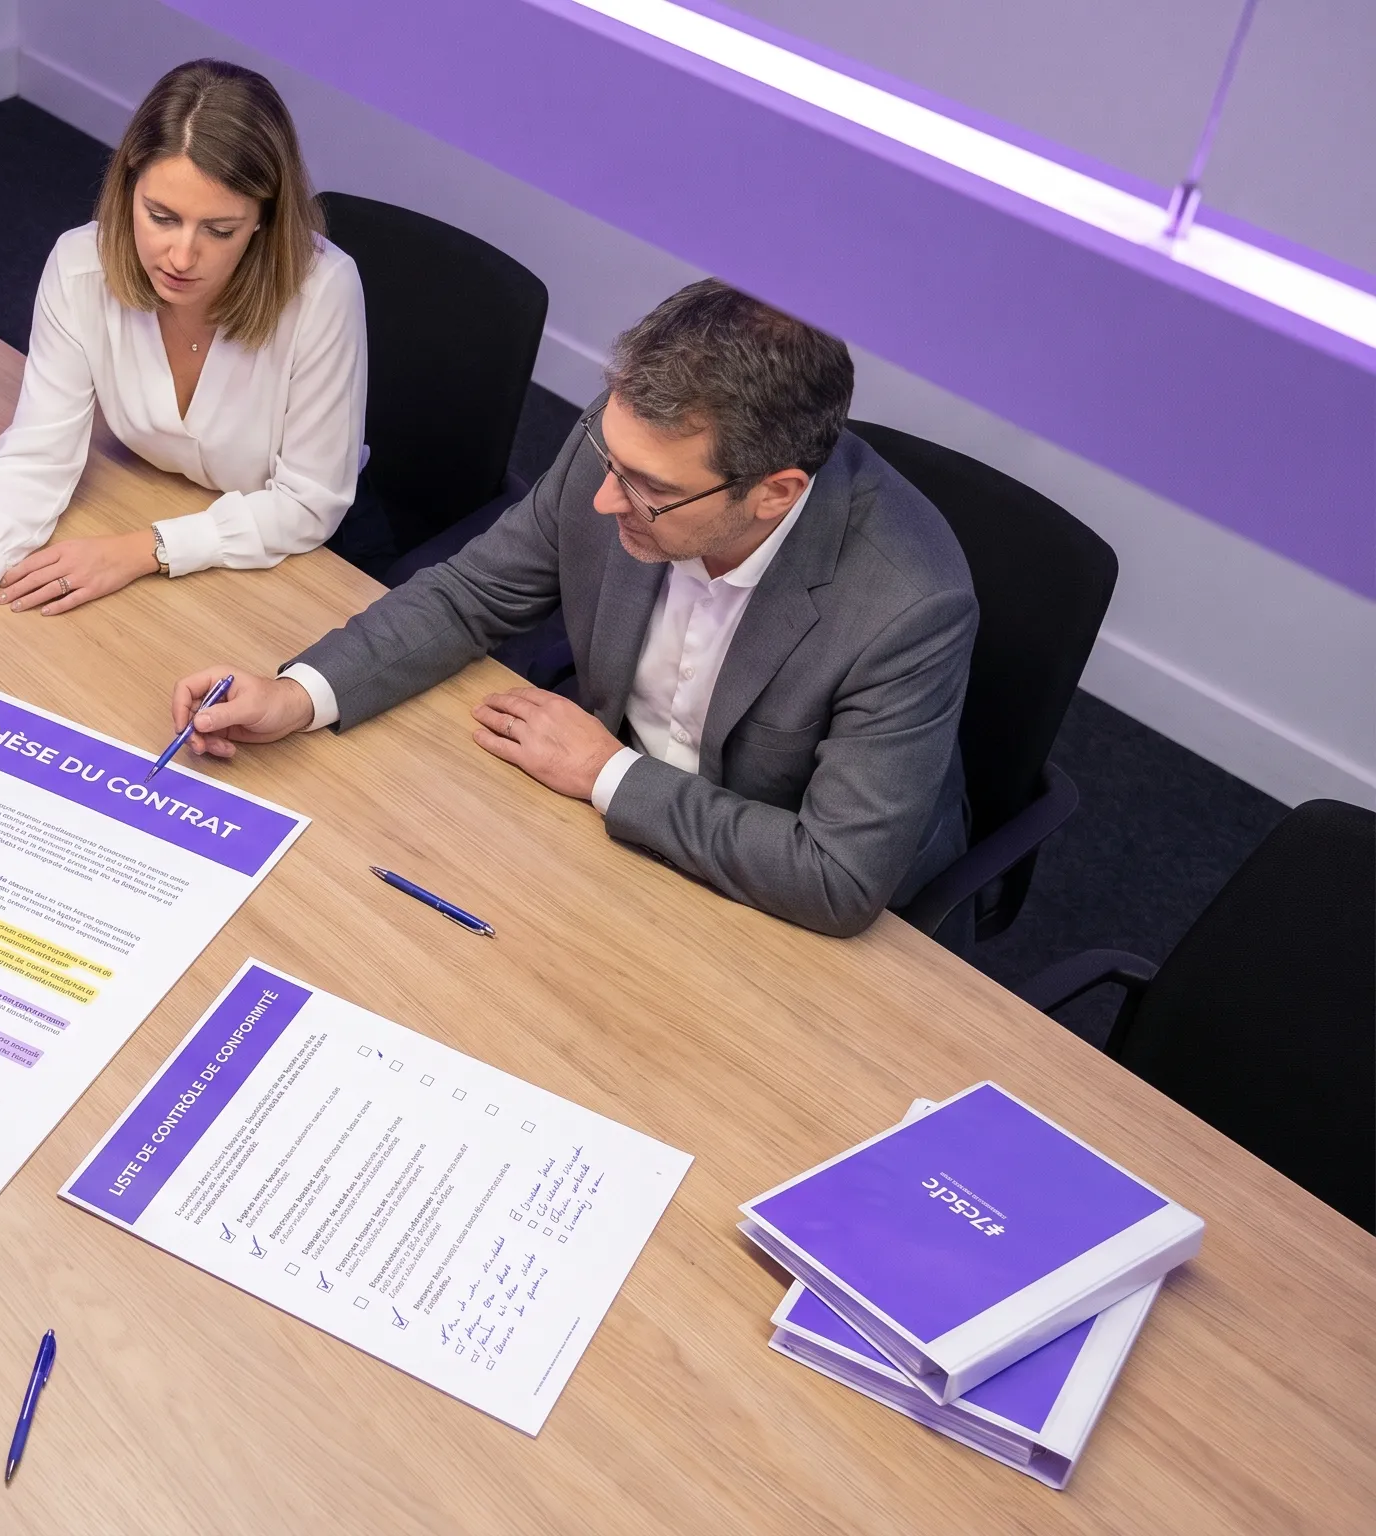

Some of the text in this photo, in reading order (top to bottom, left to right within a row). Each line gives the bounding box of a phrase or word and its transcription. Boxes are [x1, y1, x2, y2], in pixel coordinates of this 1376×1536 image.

[58, 755, 106, 782] DU
[106, 776, 242, 839] CONTRAT
[108, 989, 279, 1197] LISTE DE CONTRÔLE DE CONFORMITÉ
